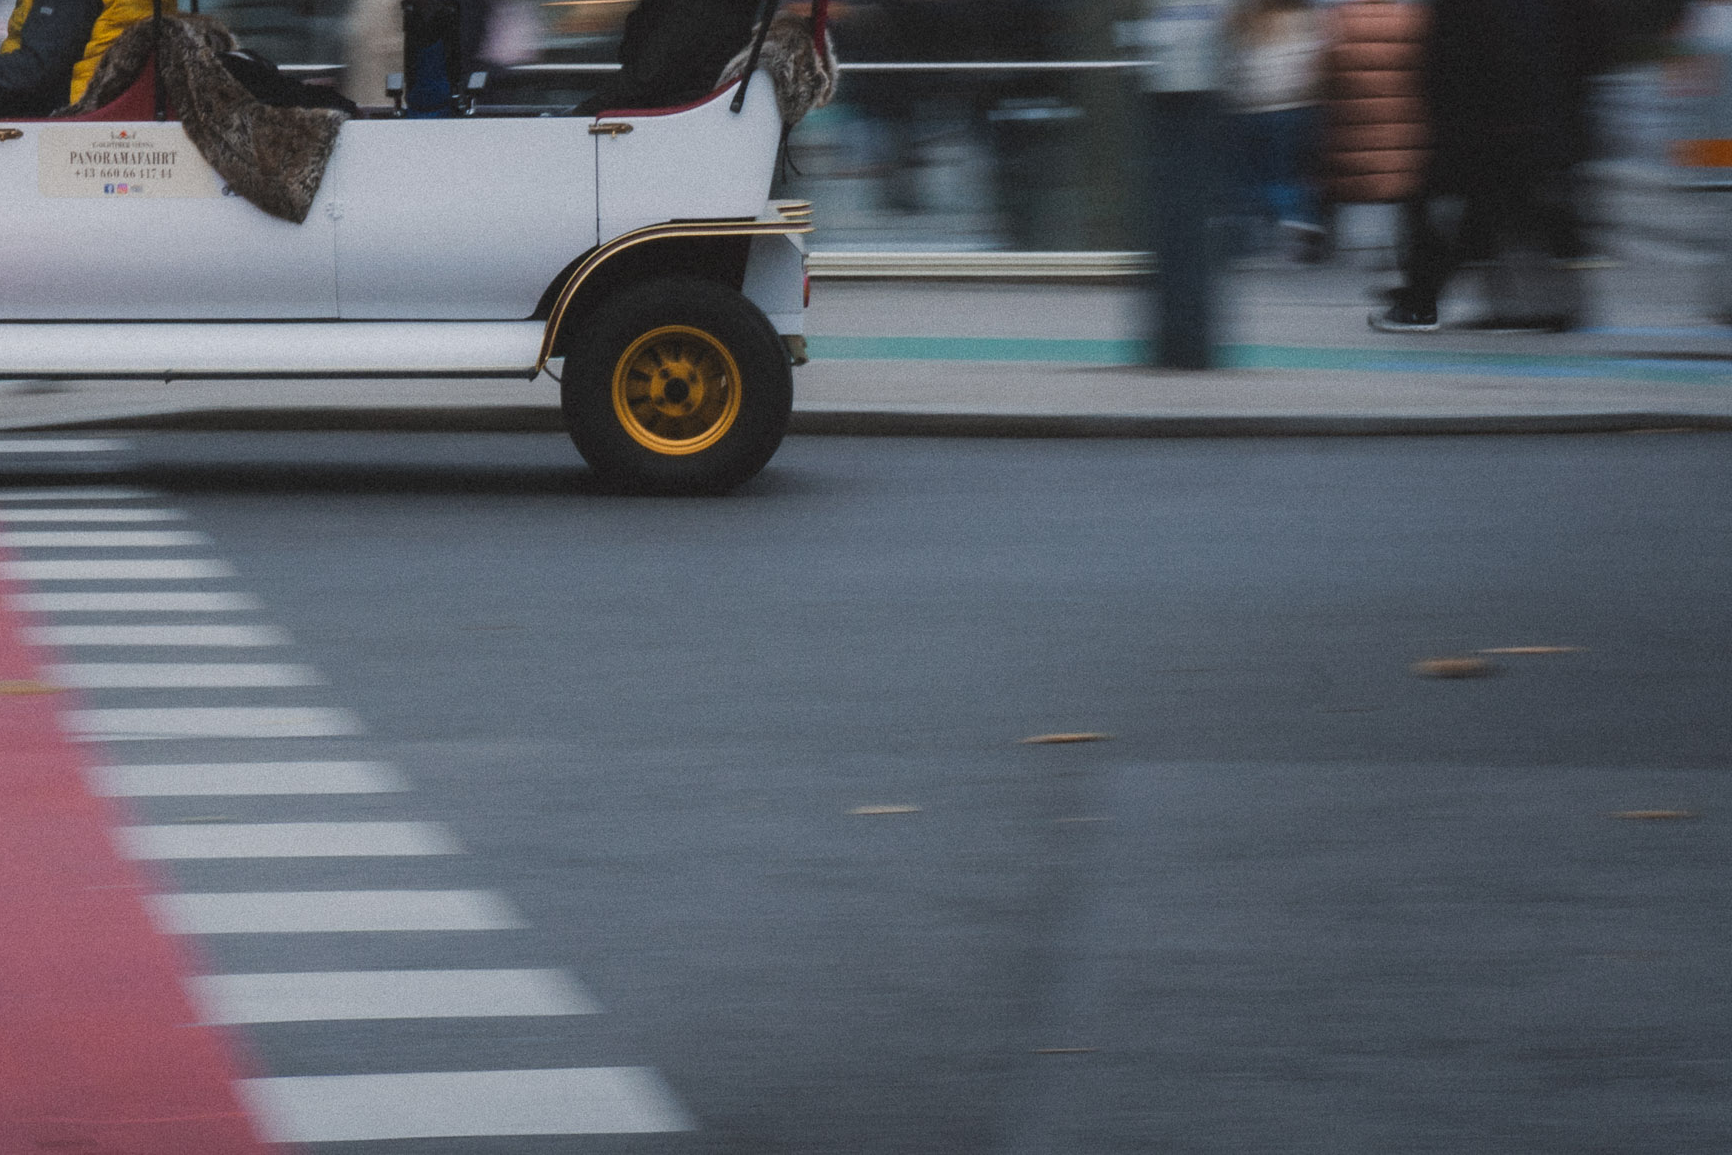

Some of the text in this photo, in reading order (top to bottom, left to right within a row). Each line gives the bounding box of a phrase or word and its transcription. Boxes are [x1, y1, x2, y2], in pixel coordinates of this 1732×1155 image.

[69, 151, 177, 165] PANORAMAFAHRT
[100, 168, 120, 179] 660
[123, 168, 136, 179] 66
